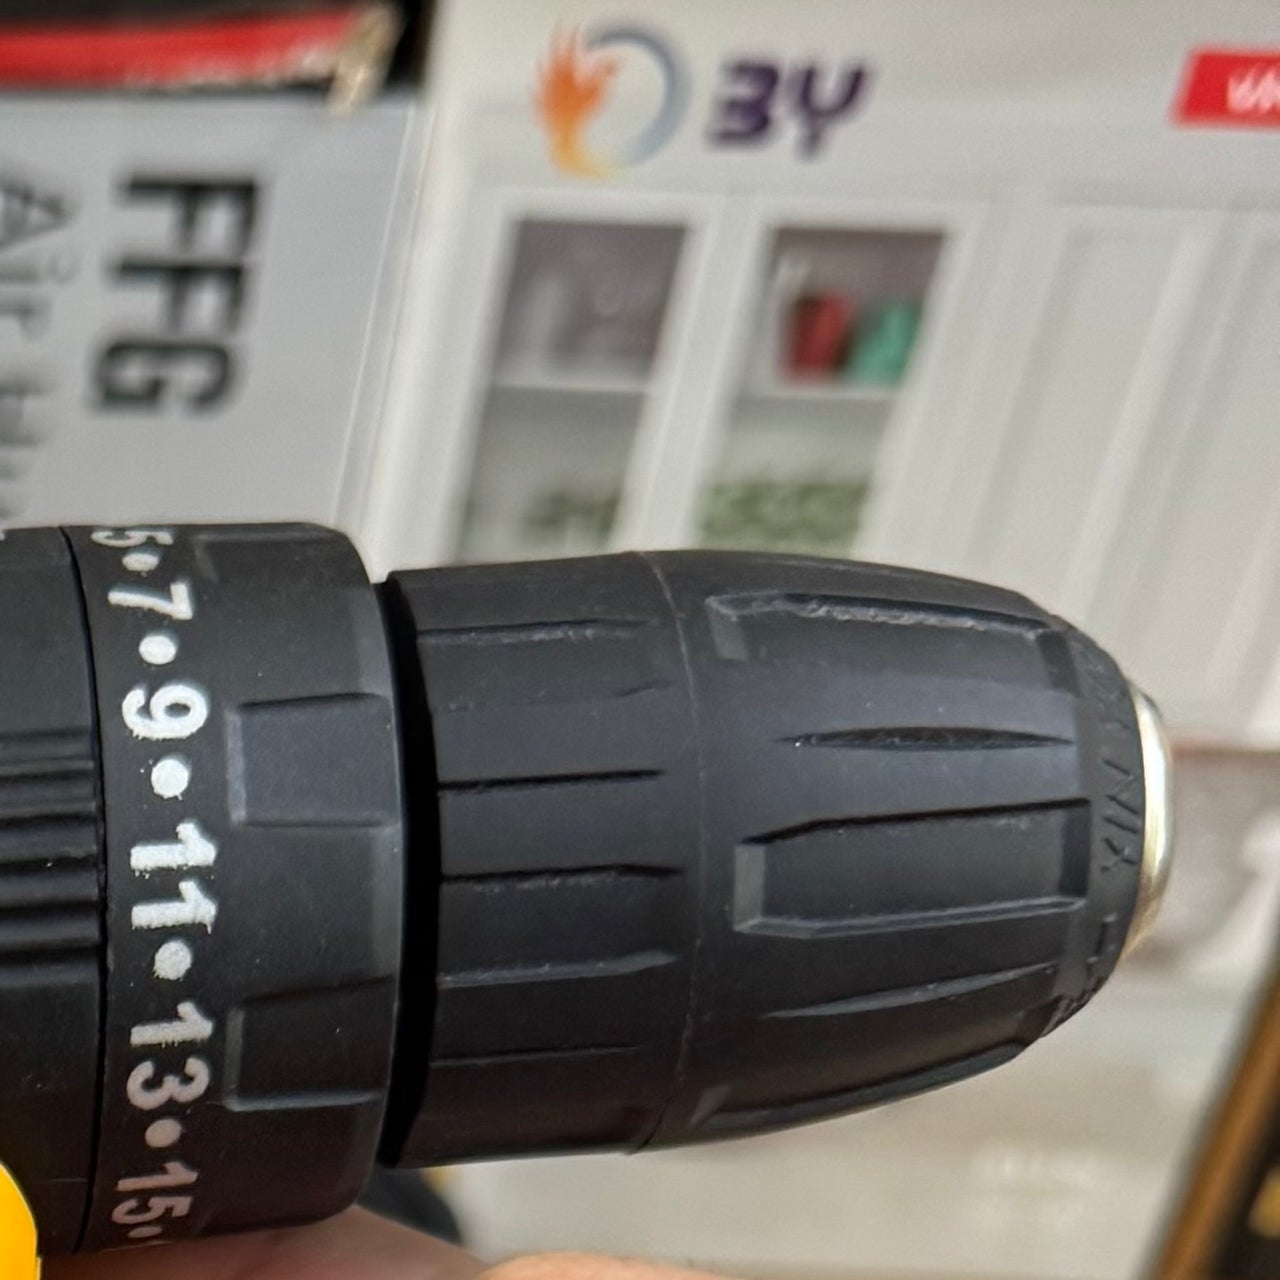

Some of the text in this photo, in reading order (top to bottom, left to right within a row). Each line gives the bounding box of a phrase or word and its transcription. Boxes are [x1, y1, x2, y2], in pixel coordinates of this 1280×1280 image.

[90, 170, 262, 414] FFG
[107, 581, 192, 620] 7
[121, 684, 208, 740] 9
[129, 821, 218, 934] 11
[126, 1001, 213, 1110] 13
[111, 1160, 198, 1224] 15
